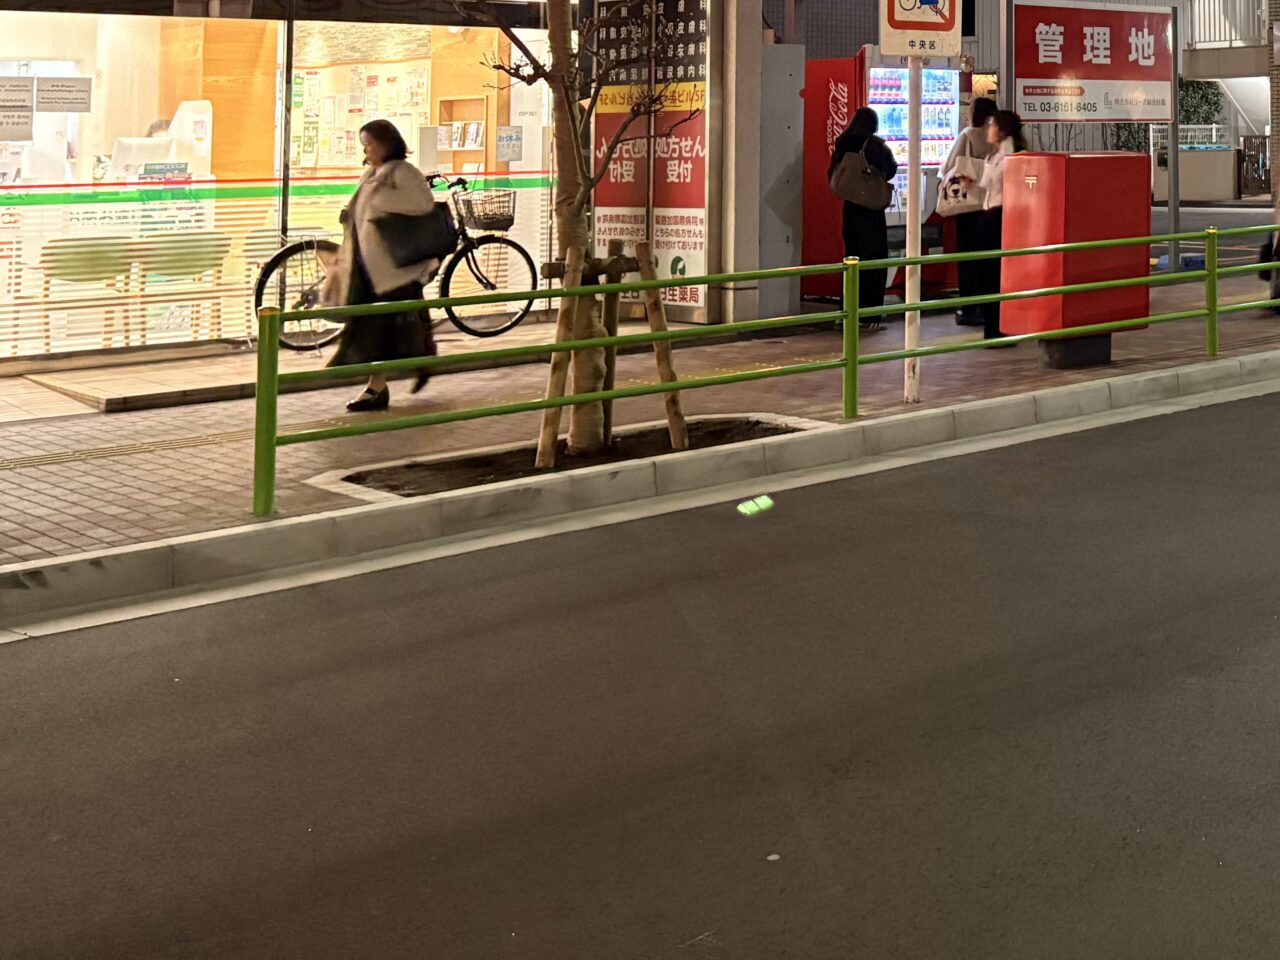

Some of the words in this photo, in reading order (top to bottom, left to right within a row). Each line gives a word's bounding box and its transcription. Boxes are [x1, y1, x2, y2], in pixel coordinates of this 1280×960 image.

[908, 40, 937, 50] 中央区
[1035, 22, 1156, 67] 管理地
[1023, 102, 1038, 112] TEL
[1040, 102, 1098, 113] 03-6161-6405
[655, 136, 706, 159] 処方せん
[666, 160, 692, 184] 受付
